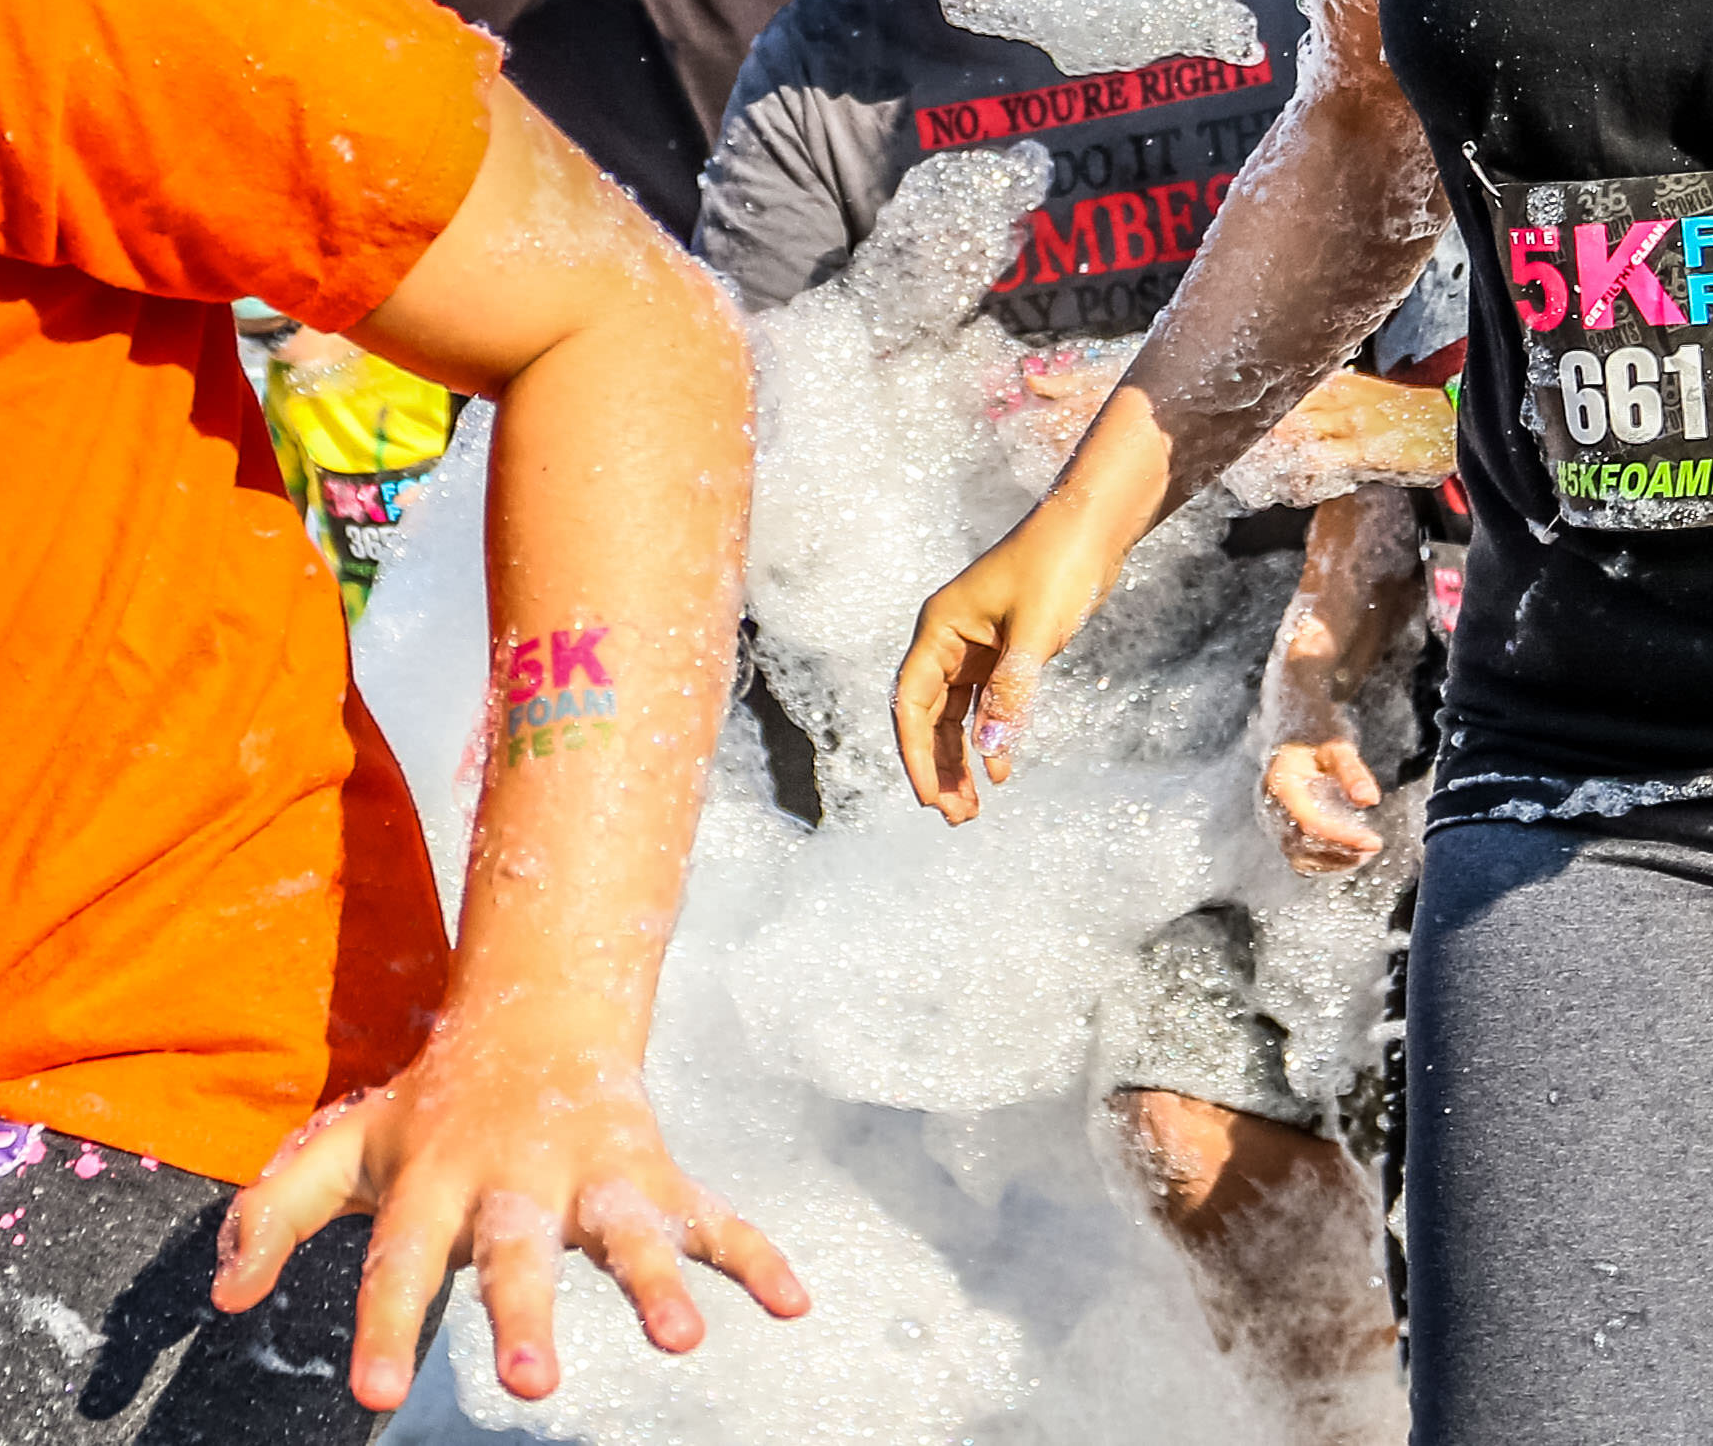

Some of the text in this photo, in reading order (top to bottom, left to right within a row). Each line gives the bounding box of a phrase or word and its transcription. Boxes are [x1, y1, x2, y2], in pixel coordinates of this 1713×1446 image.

[999, 76, 1130, 133] YOU'RE
[1131, 127, 1184, 182] IT
[1195, 110, 1276, 167] TH
[1510, 231, 1555, 245] THE
[1508, 218, 1689, 332] 5K
[508, 627, 614, 704] 5K
[508, 689, 617, 737] FOAM
[507, 722, 616, 768] FEST
